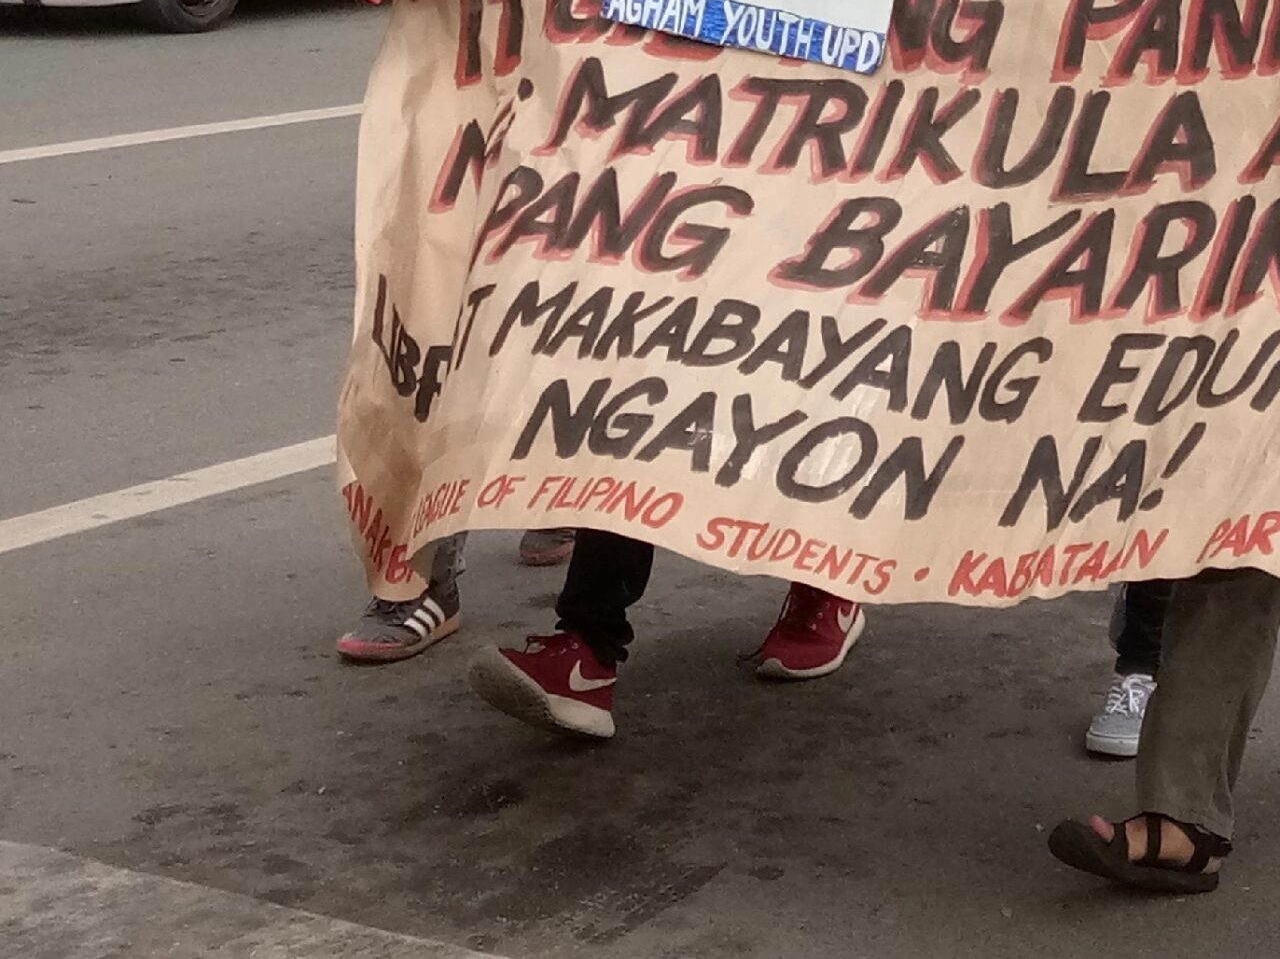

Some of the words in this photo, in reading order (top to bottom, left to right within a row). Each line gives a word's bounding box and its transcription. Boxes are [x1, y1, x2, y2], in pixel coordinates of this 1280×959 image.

[721, 0, 813, 58] YOUTH
[821, 29, 882, 70] UPD
[531, 56, 1217, 202] MATRIKULA
[466, 163, 756, 282] PANG
[488, 279, 1056, 425] MAKABAYANG
[510, 376, 966, 522] NGAYON
[998, 422, 1207, 532] NA!
[477, 474, 526, 509] OF
[528, 473, 685, 530] FILIPINO
[695, 517, 898, 595] STUDENTS
